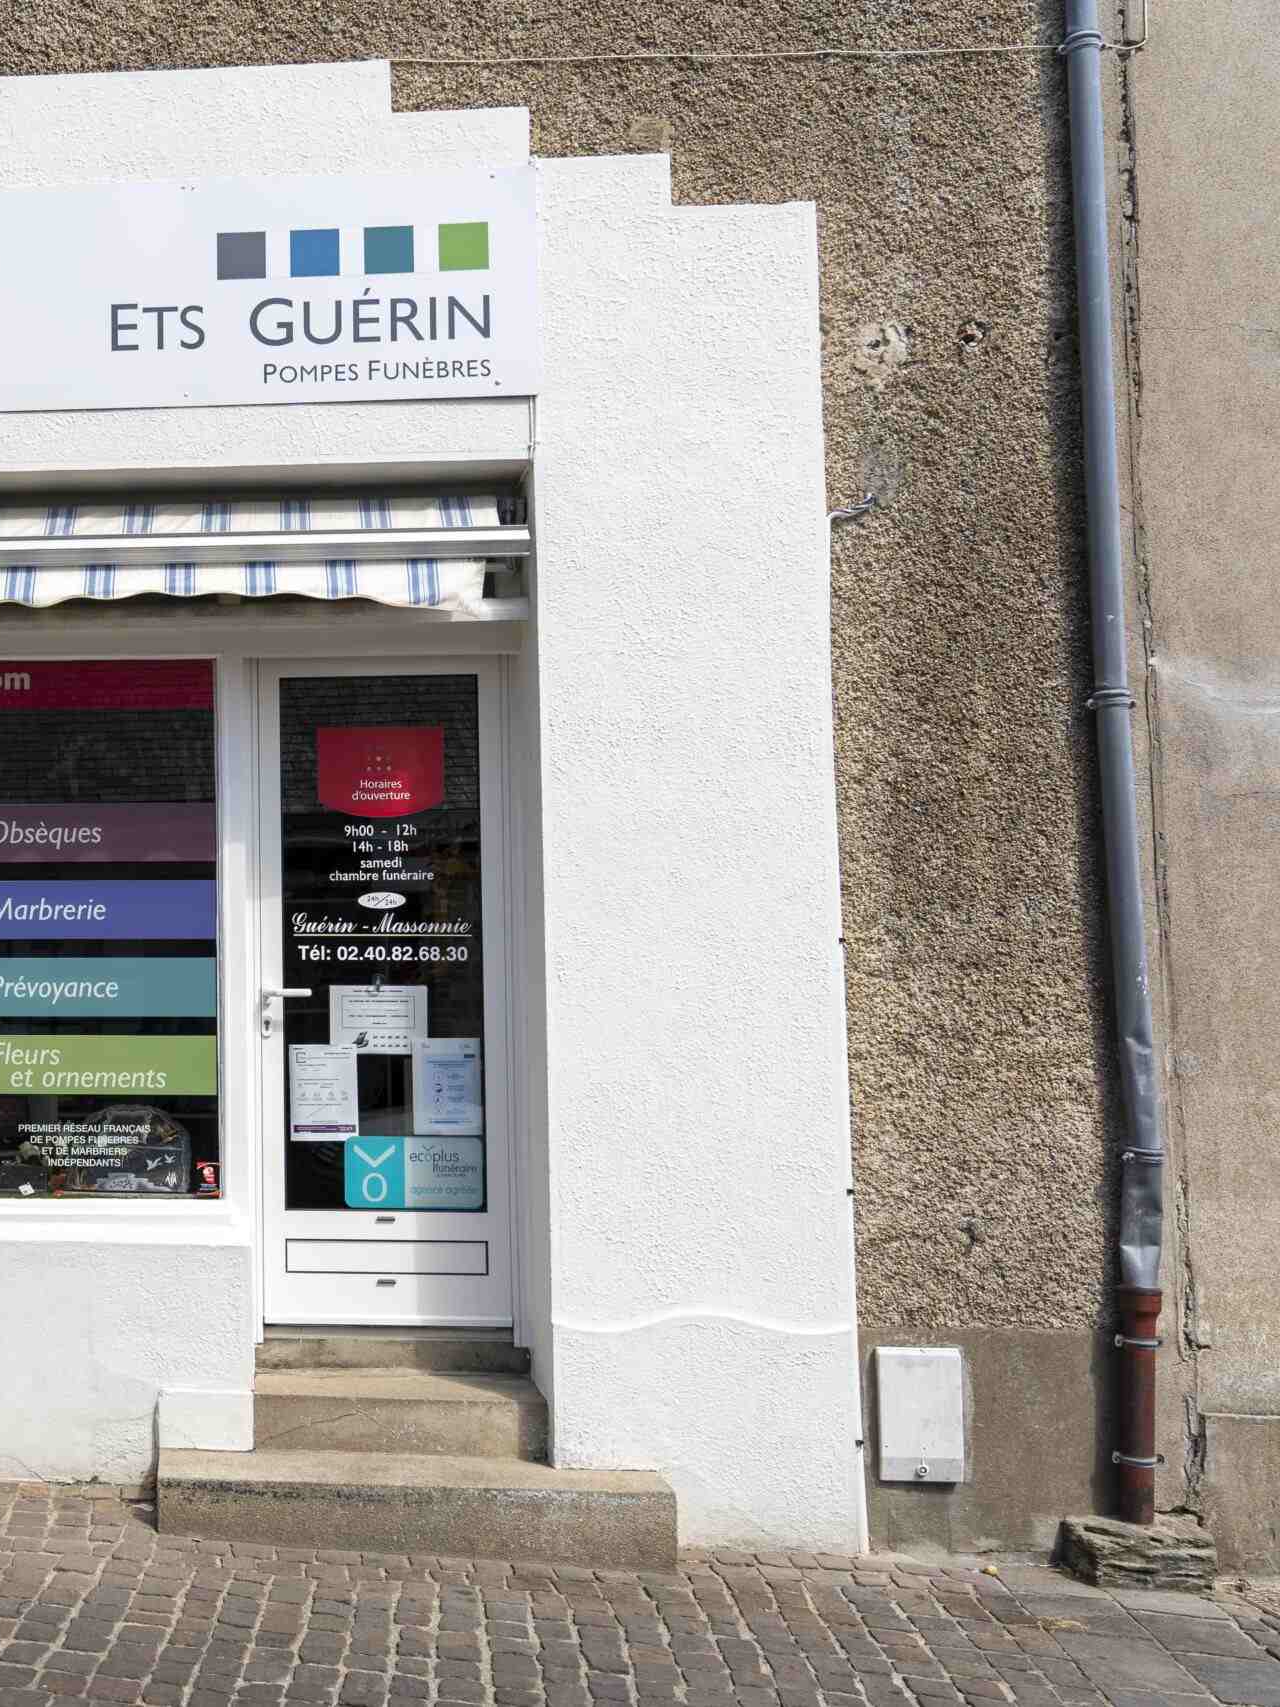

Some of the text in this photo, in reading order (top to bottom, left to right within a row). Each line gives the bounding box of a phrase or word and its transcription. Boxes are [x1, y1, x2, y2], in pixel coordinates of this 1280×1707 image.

[111, 288, 492, 352] ETS GUÉRIN
[263, 356, 492, 384] POMPES FUNÈBRES
[360, 779, 402, 790] Horaires
[344, 824, 374, 837] 9h00
[396, 824, 417, 836] 12h
[352, 840, 373, 853] 14h
[388, 840, 409, 852] 18h
[360, 857, 402, 869] samedi
[329, 869, 435, 881] chambre funéraire
[292, 912, 357, 933] Guérin
[373, 911, 473, 934] Massonnie
[298, 945, 468, 961] Tél: 02.40.82.68.30
[10, 1069, 167, 1089] et ornements
[18, 1122, 151, 1135] PREMIER RÉSEAU FRANÇAIS
[30, 1136, 43, 1144] DE
[46, 1136, 86, 1145] POMPES
[42, 1147, 128, 1156] ET DE MARBRIERS
